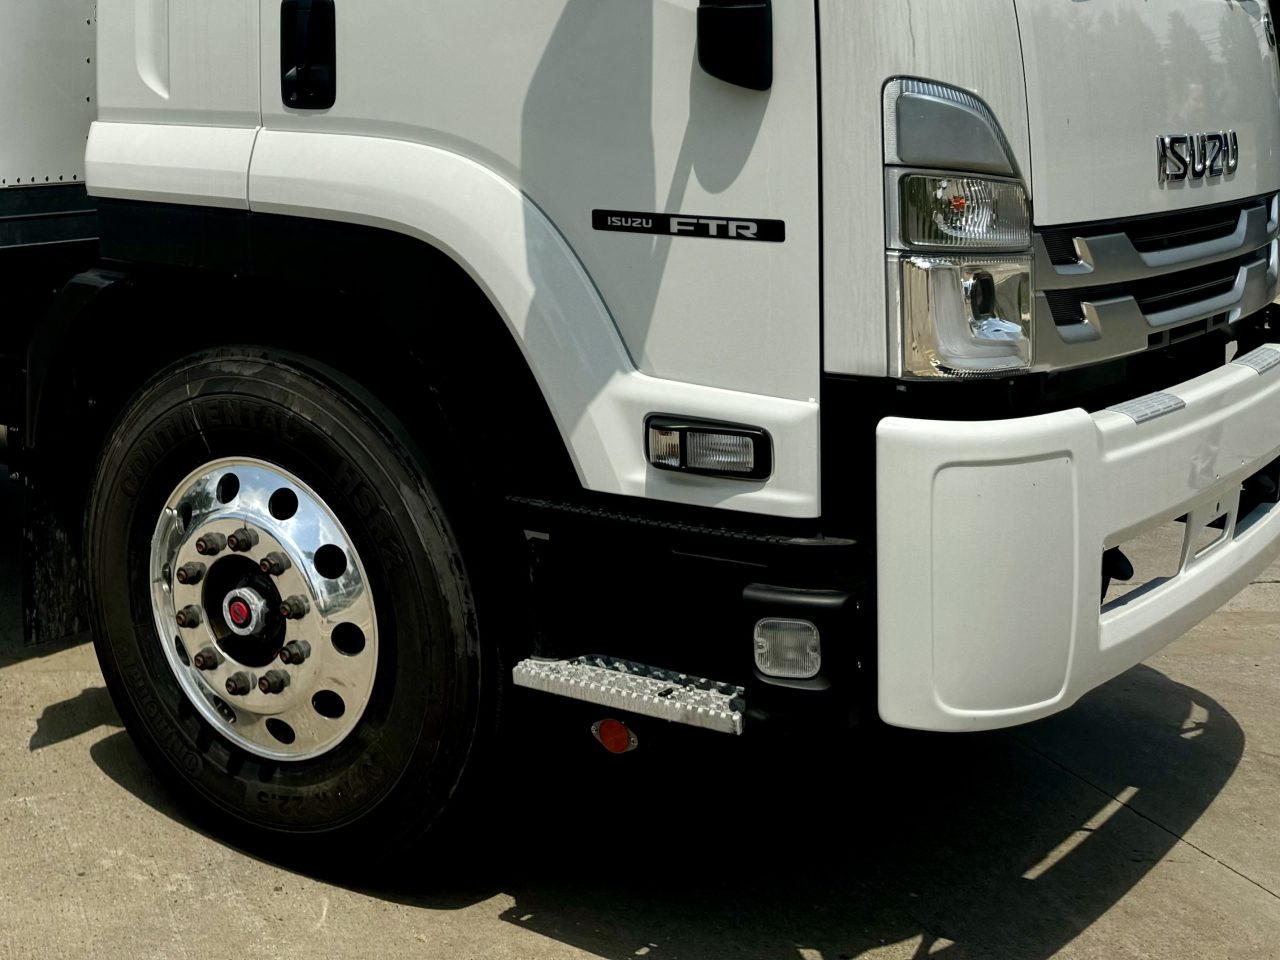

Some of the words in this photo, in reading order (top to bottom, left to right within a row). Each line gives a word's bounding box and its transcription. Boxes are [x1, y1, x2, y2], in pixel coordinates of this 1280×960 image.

[1156, 129, 1238, 184] ISUZU
[607, 216, 653, 228] ISUZU
[669, 216, 758, 239] FTR
